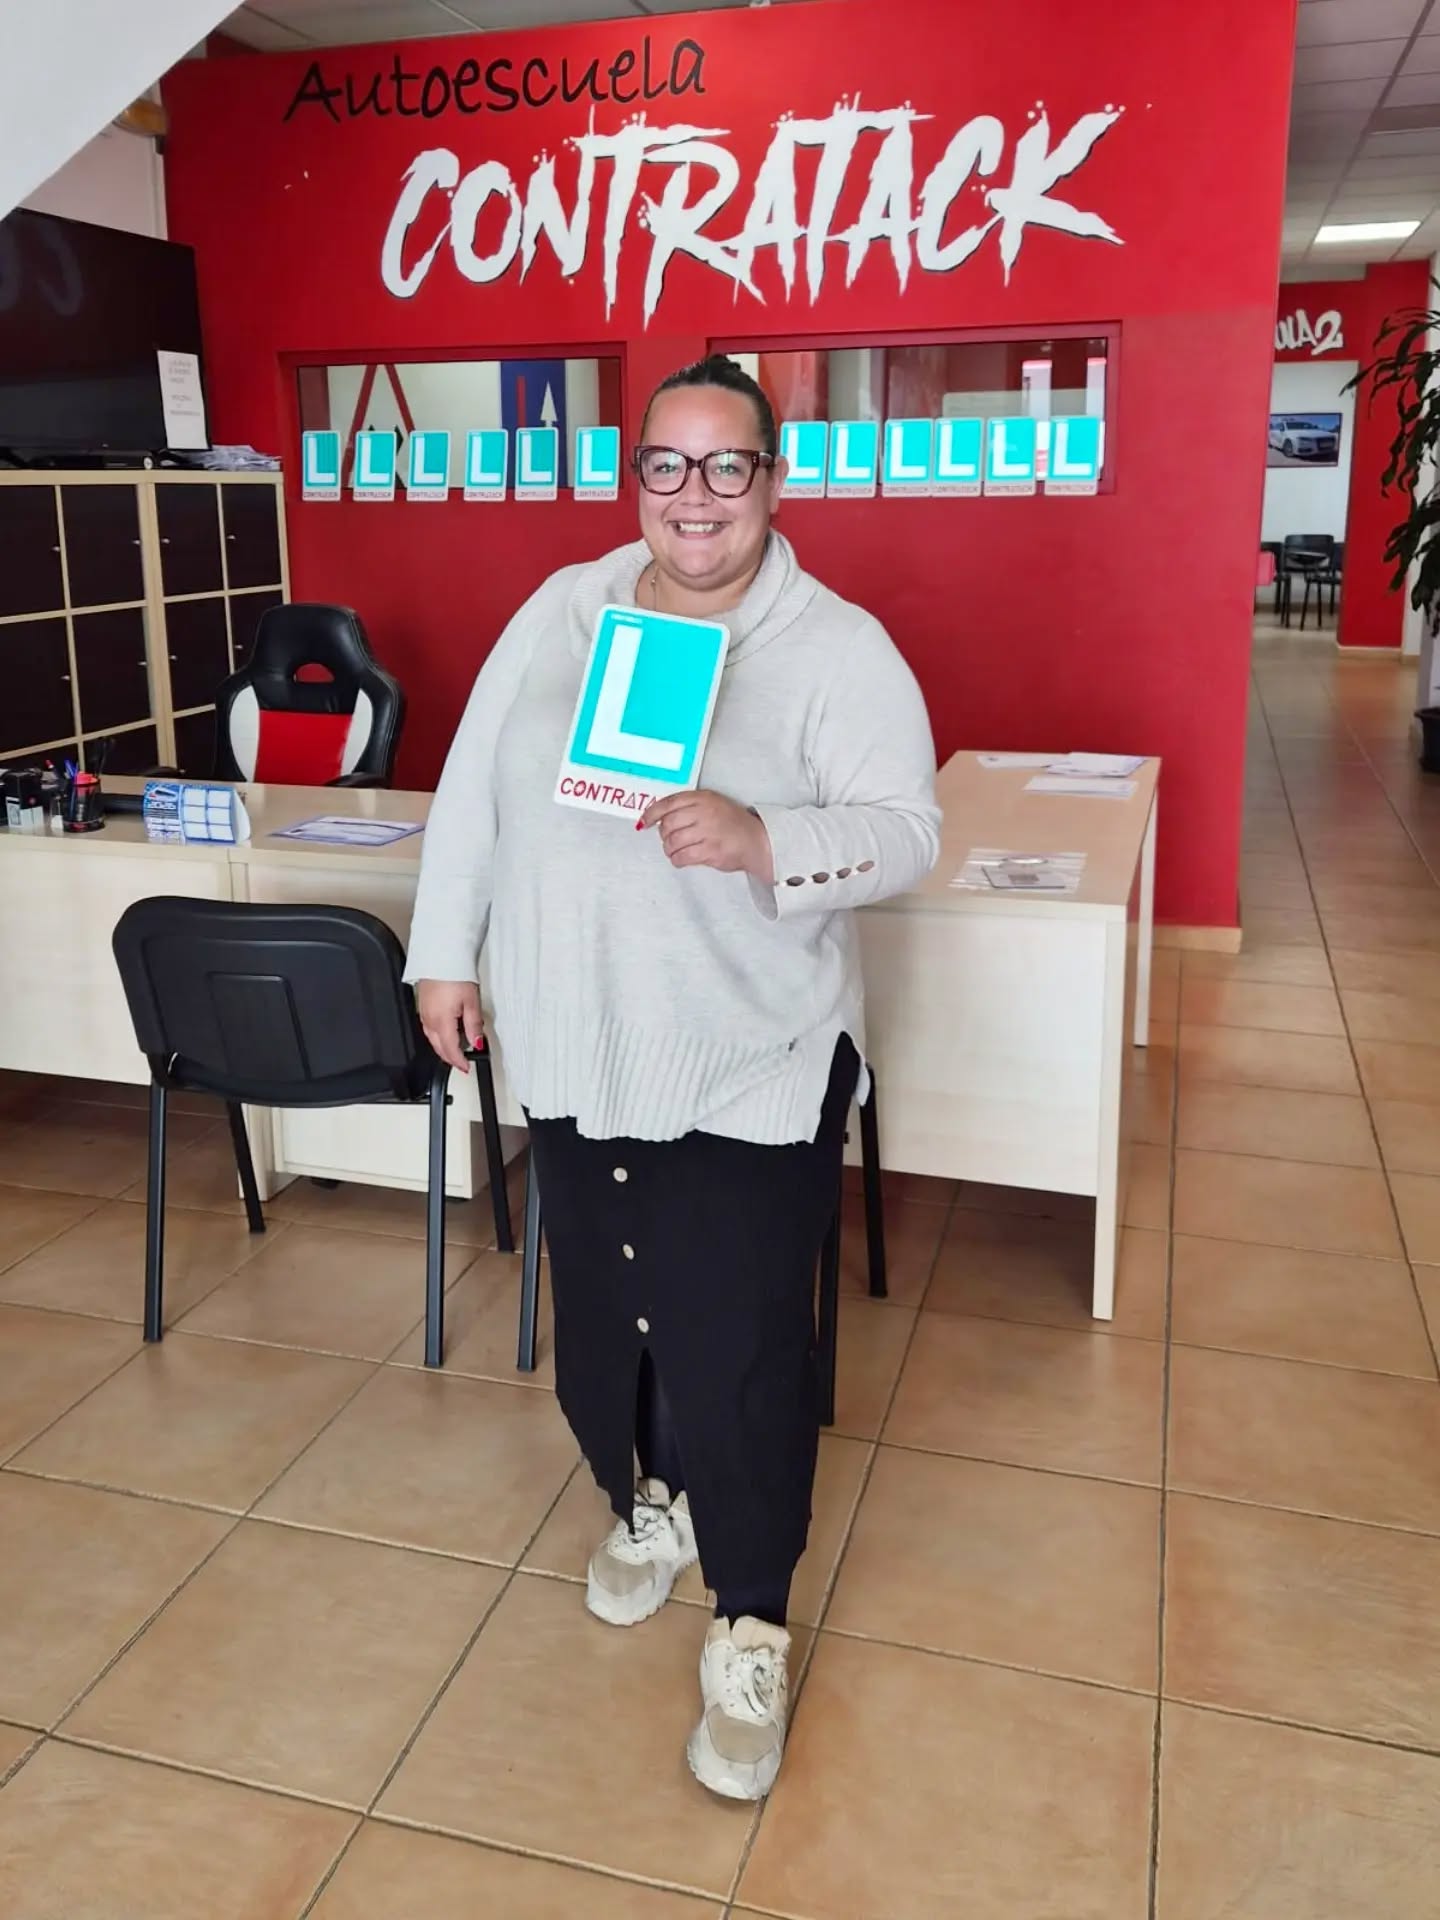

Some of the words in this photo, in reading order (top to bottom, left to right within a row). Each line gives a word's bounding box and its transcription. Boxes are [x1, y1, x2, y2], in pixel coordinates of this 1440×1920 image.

[283, 36, 706, 122] Autoescuela
[381, 96, 1125, 329] CONTRATACK
[1275, 309, 1344, 355] ULA2
[307, 437, 336, 483] L
[360, 437, 390, 483] L
[413, 437, 444, 483] L
[471, 435, 502, 483] L
[521, 433, 553, 482] L
[580, 433, 613, 482] L
[786, 427, 820, 478] L
[835, 427, 871, 478] L
[890, 426, 927, 478] L
[938, 424, 976, 476] L
[992, 424, 1031, 476] L
[1053, 422, 1092, 475] L
[585, 624, 685, 771] L
